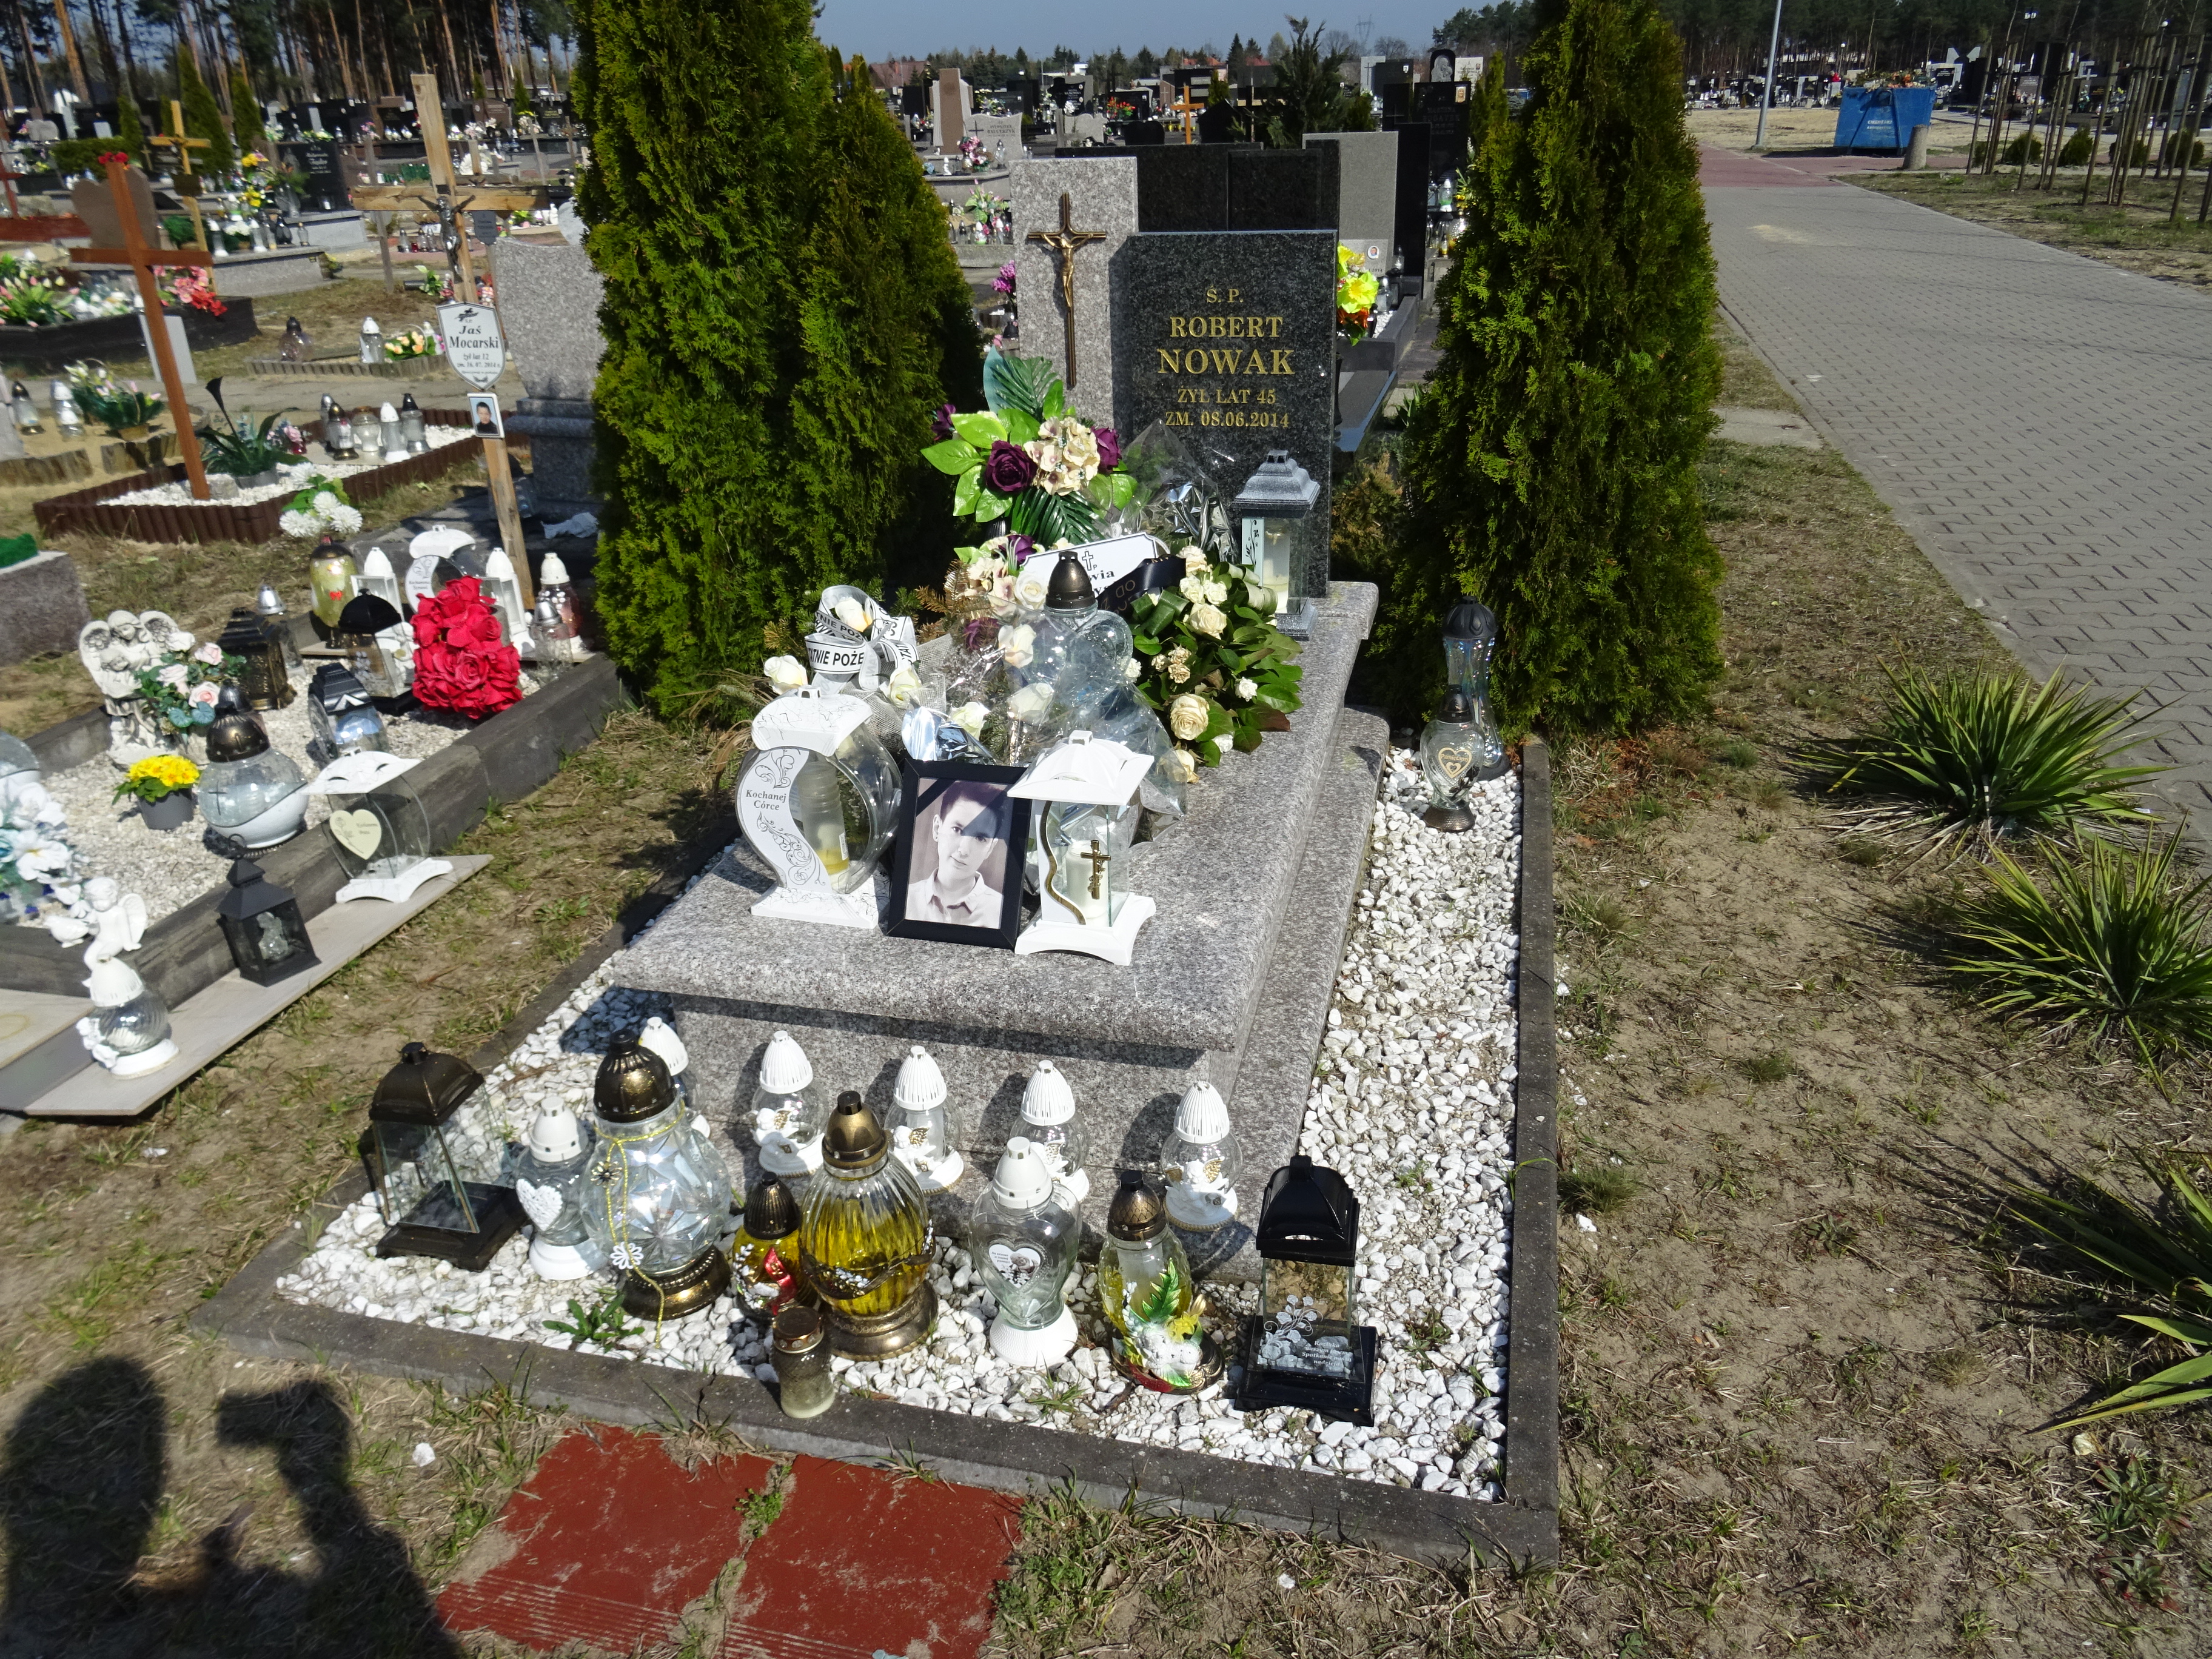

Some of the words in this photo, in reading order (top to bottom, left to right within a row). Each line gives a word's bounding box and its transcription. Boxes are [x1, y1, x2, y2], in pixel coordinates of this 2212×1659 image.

[459, 325, 481, 335] Jaś
[1170, 317, 1283, 338] ROBERT
[449, 336, 499, 349] Mocarski
[1157, 348, 1296, 375] NOWAK
[1178, 385, 1210, 403] ŻYŁ
[1216, 389, 1251, 404] LAT
[1256, 389, 1276, 404] 45
[1165, 412, 1194, 426] ZM.
[1201, 411, 1290, 428] 08.06.2014
[840, 625, 863, 641] POŻ
[833, 651, 865, 666] POŻE
[745, 789, 786, 803] Kochanej
[754, 800, 780, 811] Córce
